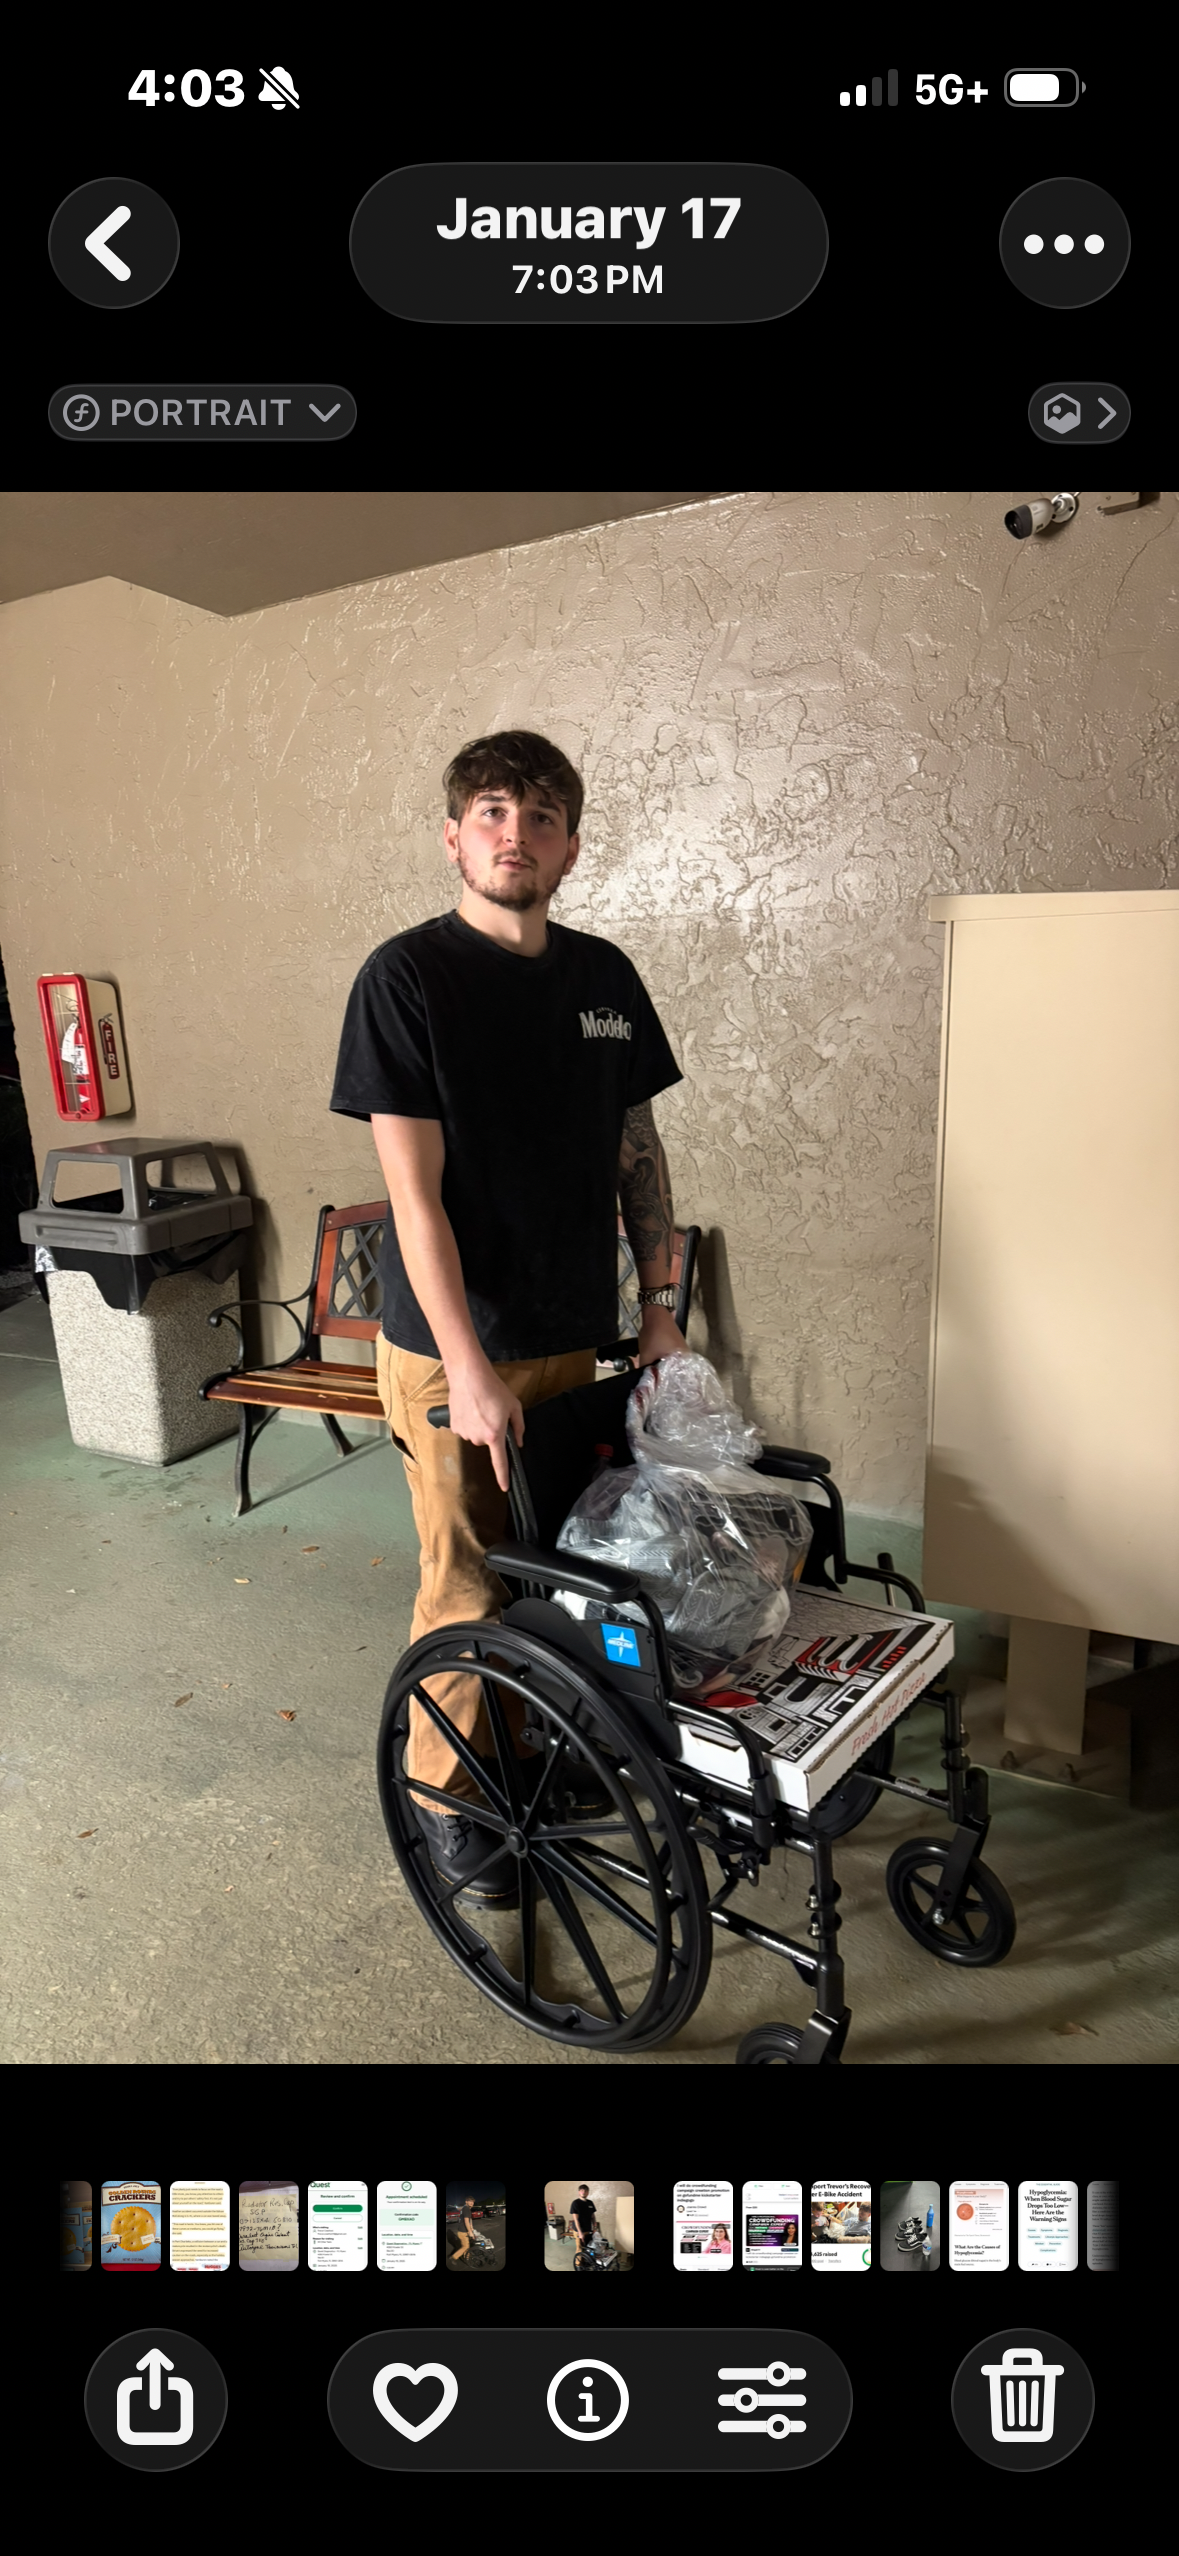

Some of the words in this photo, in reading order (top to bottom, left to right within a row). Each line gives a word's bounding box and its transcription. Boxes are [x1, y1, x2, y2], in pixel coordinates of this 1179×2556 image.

[105, 1030, 118, 1075] FIRE
[851, 1715, 879, 1756] Fresh
[881, 1694, 900, 1726] Hot
